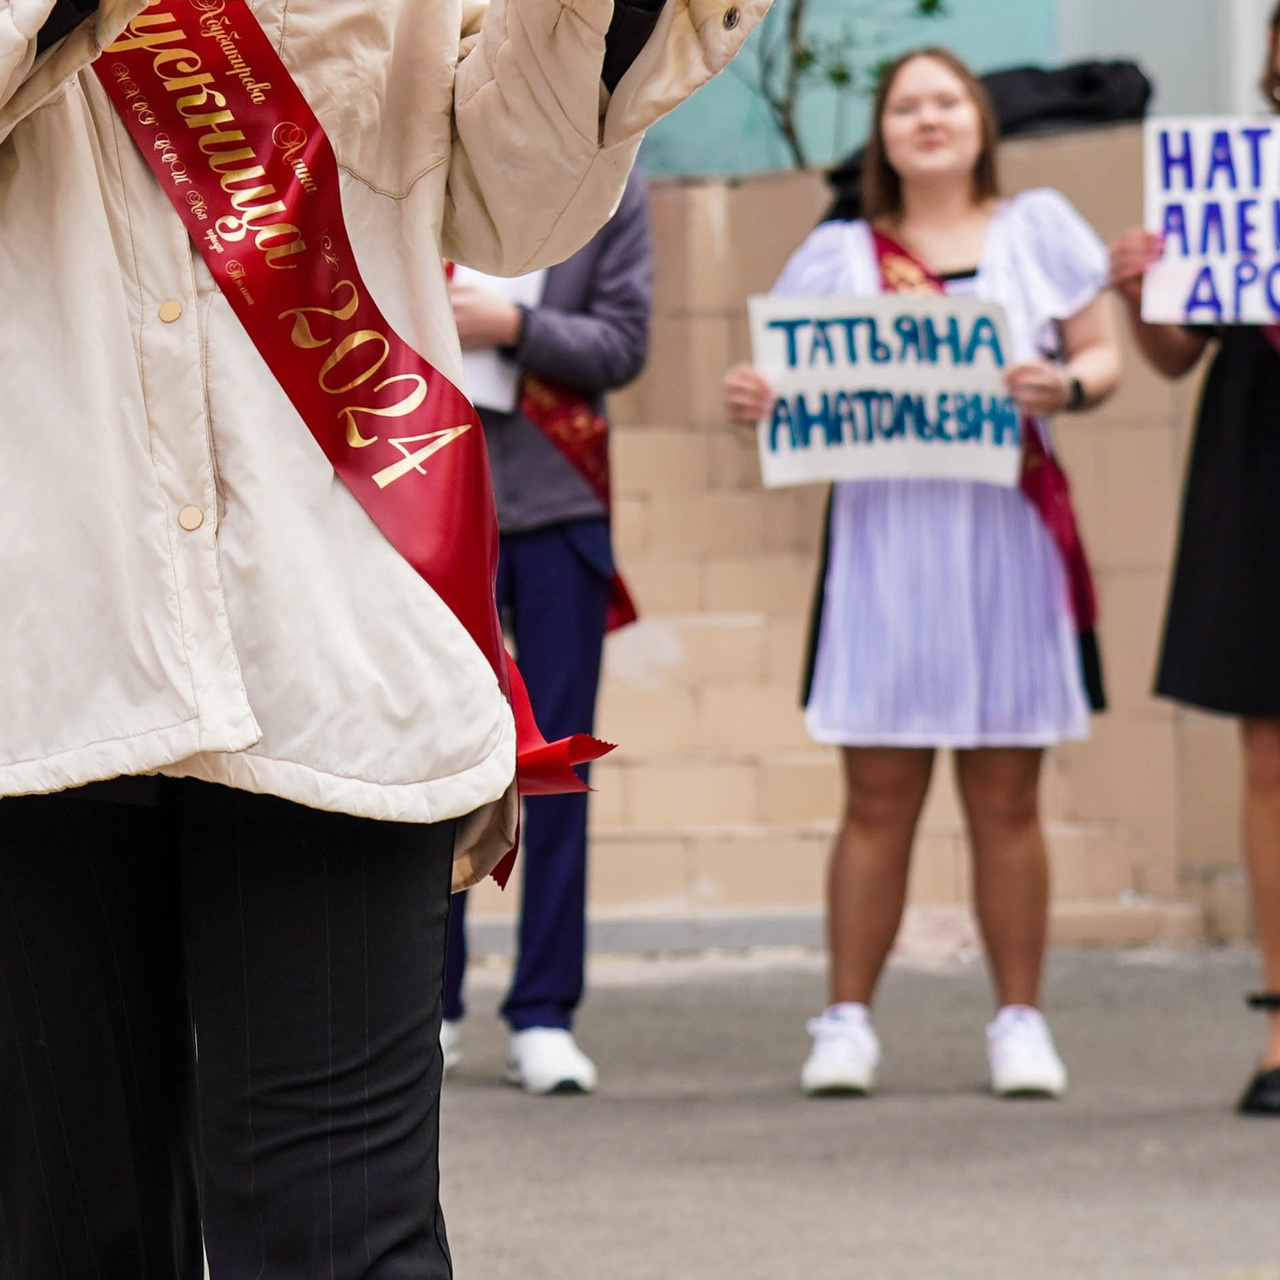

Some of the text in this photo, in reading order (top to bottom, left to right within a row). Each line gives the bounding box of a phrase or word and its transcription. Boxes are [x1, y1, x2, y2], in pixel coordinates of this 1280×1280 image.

[272, 121, 319, 196] Алина
[766, 314, 1005, 368] ТАТЬЯНА
[277, 279, 473, 489] 2024
